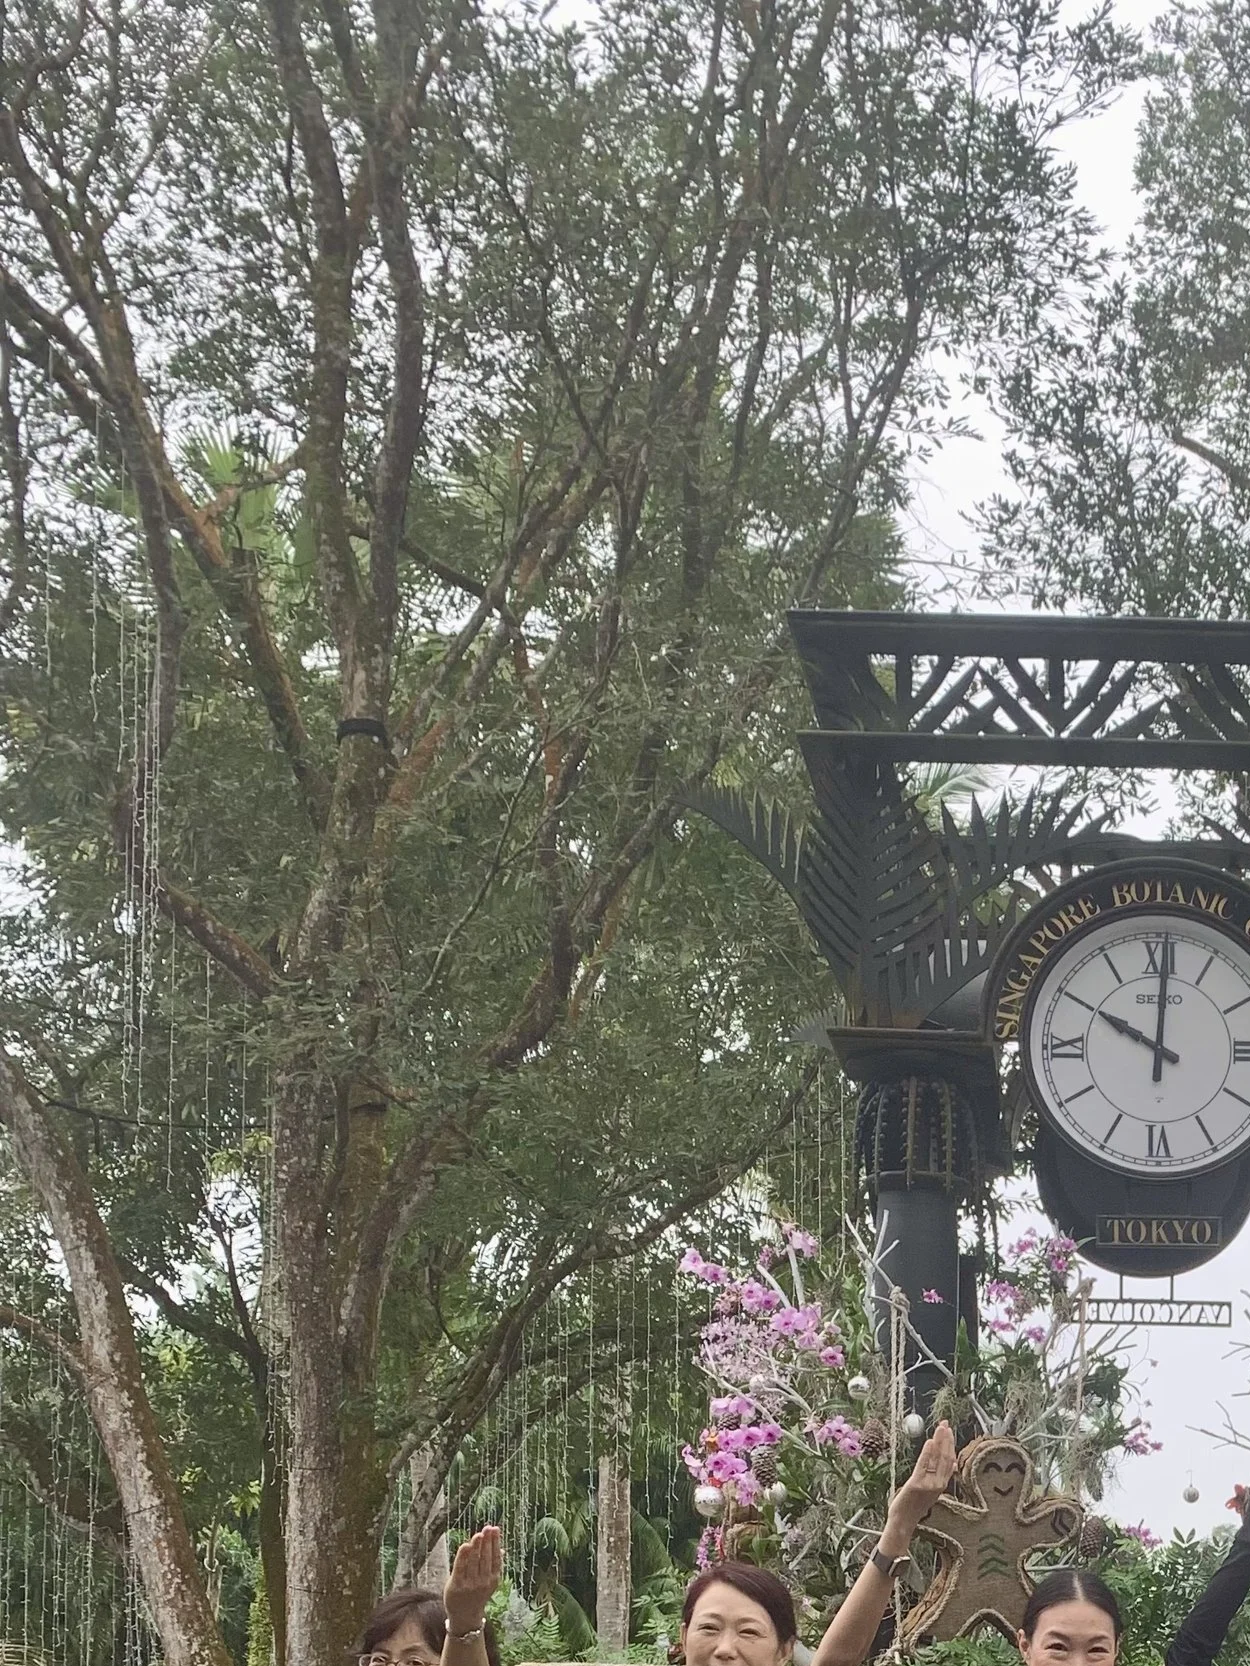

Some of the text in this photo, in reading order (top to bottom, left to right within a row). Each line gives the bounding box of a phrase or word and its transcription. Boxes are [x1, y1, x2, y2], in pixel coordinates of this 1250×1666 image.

[996, 893, 1101, 1039] SINGAPORE
[1112, 880, 1233, 920] BOTANIC
[1136, 994, 1183, 1005] SEKO
[1106, 1219, 1212, 1244] TOKYO
